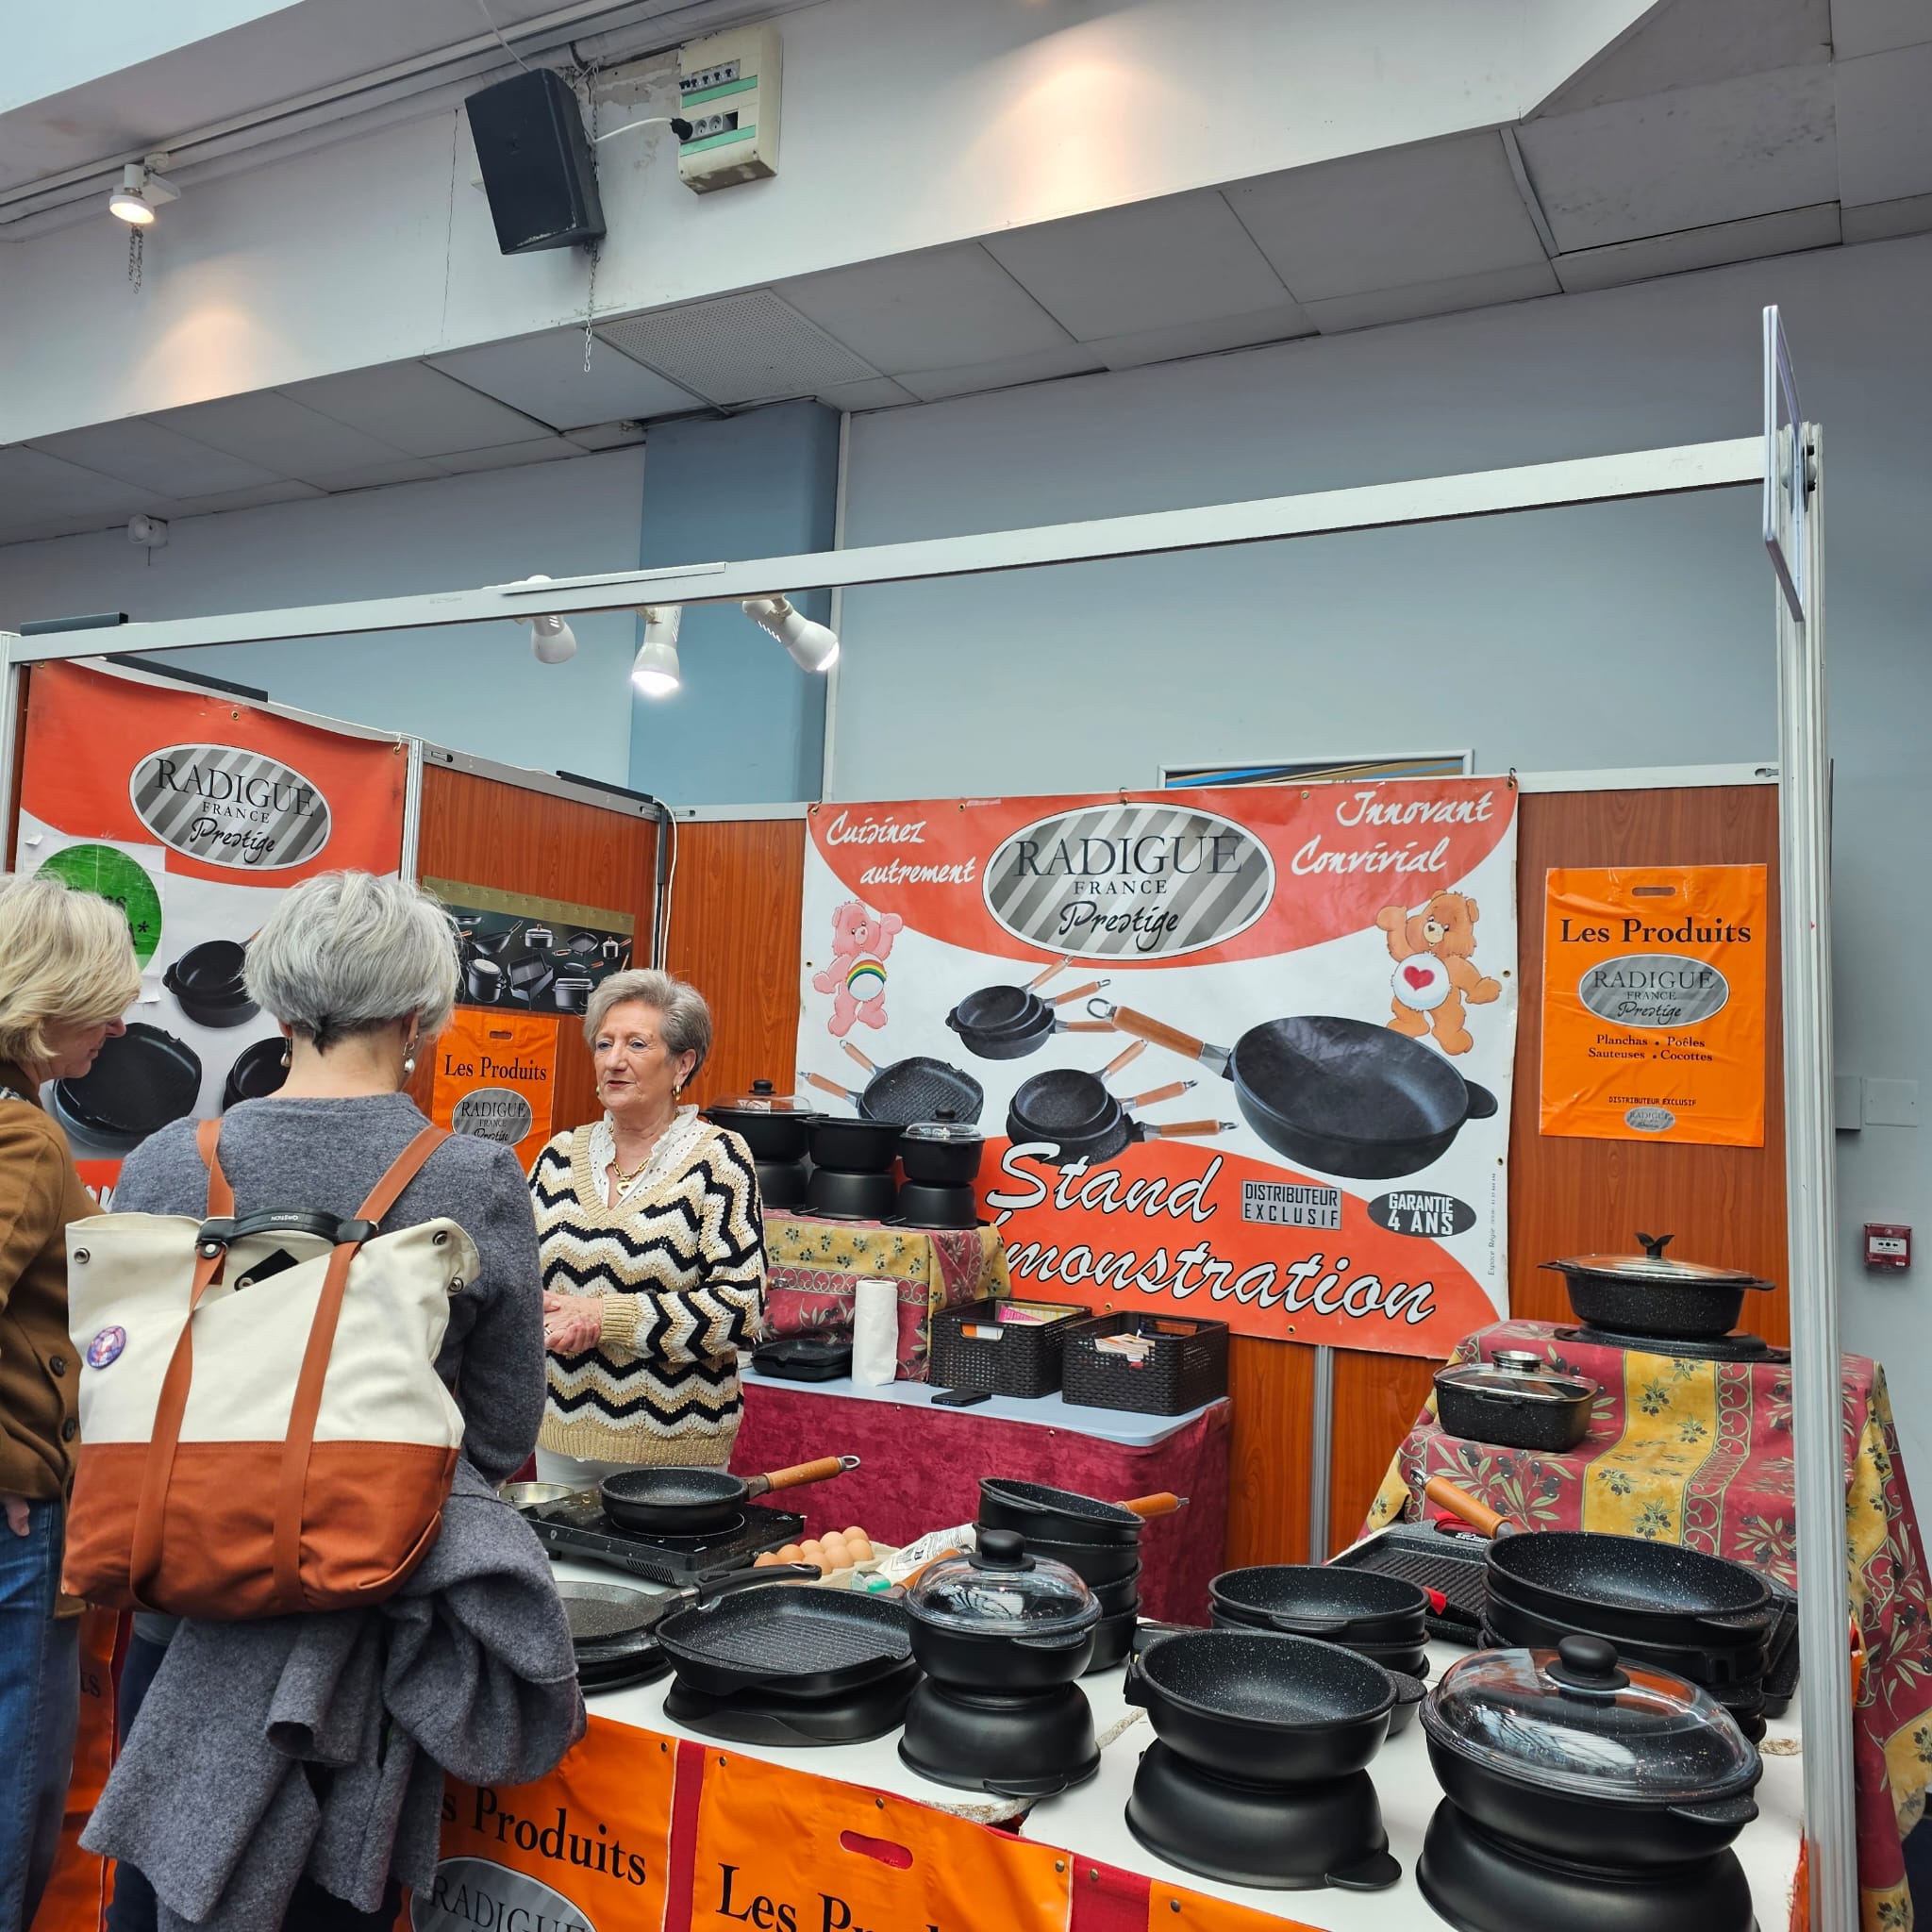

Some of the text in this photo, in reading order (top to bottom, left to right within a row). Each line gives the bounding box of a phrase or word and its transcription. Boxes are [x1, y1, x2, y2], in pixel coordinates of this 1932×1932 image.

[155, 758, 314, 817] RADIGUE
[201, 801, 271, 824] FRANCE
[1336, 790, 1493, 827] Innovant
[189, 817, 275, 864] Prestige
[825, 809, 926, 846] Cuisinez
[1013, 835, 1244, 877] RADIGUE
[1291, 834, 1451, 875] Convivial
[859, 856, 976, 885] autrement
[1073, 879, 1168, 895] FRANCE
[1058, 900, 1179, 952] Prestige
[1559, 917, 1752, 943] Les Produits
[1593, 970, 1716, 990] RADIGUE
[1625, 991, 1677, 1001] FRANCE
[1617, 1001, 1682, 1025] Prestige
[1588, 1047, 1713, 1061] Sauteuses Cocottes
[1596, 1034, 1706, 1048] Planchas Poêles
[444, 1054, 547, 1081] Les Produits
[460, 1101, 526, 1118] RADIGUE
[1608, 1095, 1697, 1107] DISTRIBUTEUR EXCLUSIF
[478, 1119, 507, 1127] FRANCE
[985, 1141, 1224, 1223] Stand
[1245, 1183, 1338, 1207] DISTRIBUTEUR
[1244, 1203, 1339, 1227] EXCLUSIF
[1388, 1192, 1454, 1214] GARANTIE
[1387, 1209, 1454, 1236] 4 ANS
[995, 1210, 1437, 1324] monstration
[471, 1786, 647, 1886] Produits
[715, 1862, 797, 1932] Les
